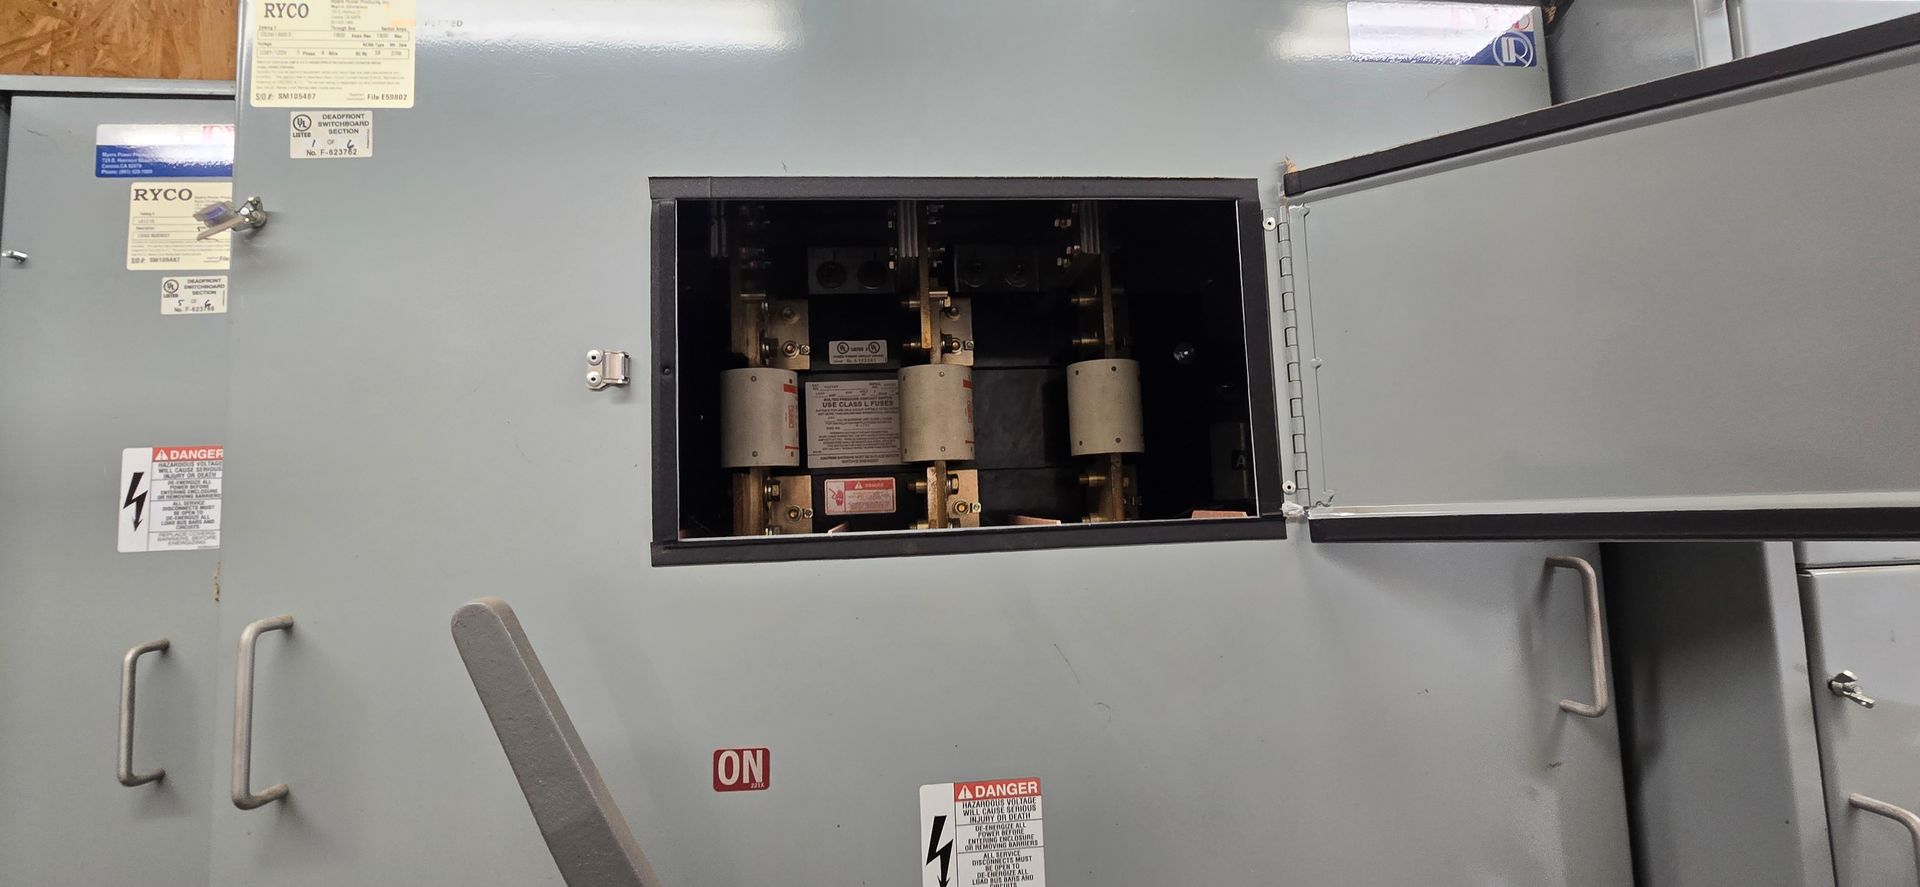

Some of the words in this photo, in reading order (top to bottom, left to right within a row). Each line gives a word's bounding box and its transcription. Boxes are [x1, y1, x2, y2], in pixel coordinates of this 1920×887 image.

[264, 3, 309, 19] RYCO
[133, 188, 193, 201] RYCO
[170, 449, 224, 460] DANGER
[718, 750, 763, 785] ON
[975, 782, 1038, 798] DANGER
[962, 799, 1005, 809] HAZARDOUS
[1007, 797, 1037, 806] VOLTAGE
[963, 808, 980, 816] WILL
[982, 807, 1005, 815] CAUSE
[1007, 805, 1037, 813] SERIOUS
[970, 816, 994, 824] INJURY
[1009, 813, 1031, 821] DEATH
[975, 824, 1014, 832] DE-ENERGIZE
[1001, 829, 1024, 837] BEFORE
[968, 837, 998, 845] ENTERING
[999, 834, 1034, 843] ENCLOSURE
[975, 843, 1007, 851] REMOVING
[1008, 840, 1038, 848] BARRIERS
[995, 850, 1021, 858] SERVICE
[972, 858, 1014, 866] DISCONNECTS
[977, 871, 1016, 879] DE-ENERGIZE
